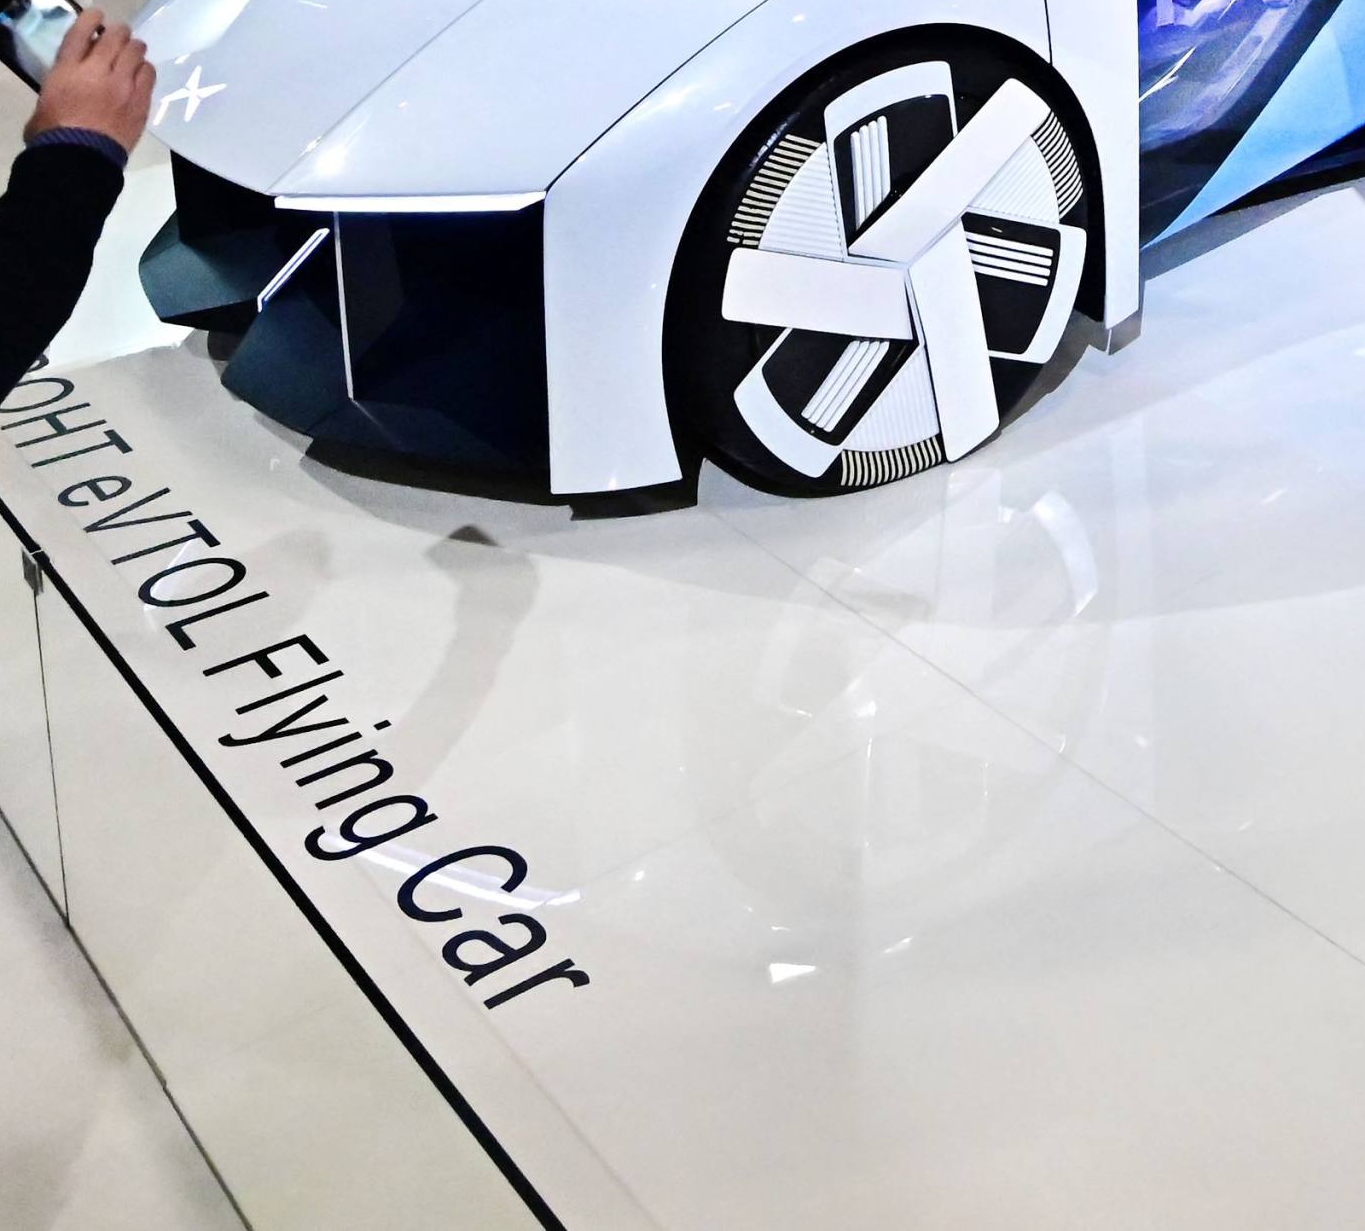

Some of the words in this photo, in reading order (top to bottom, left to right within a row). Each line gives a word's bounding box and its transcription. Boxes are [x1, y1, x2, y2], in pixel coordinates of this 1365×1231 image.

[57, 473, 270, 652] eVTOL
[202, 632, 440, 862] Flying
[395, 843, 592, 1012] Car
